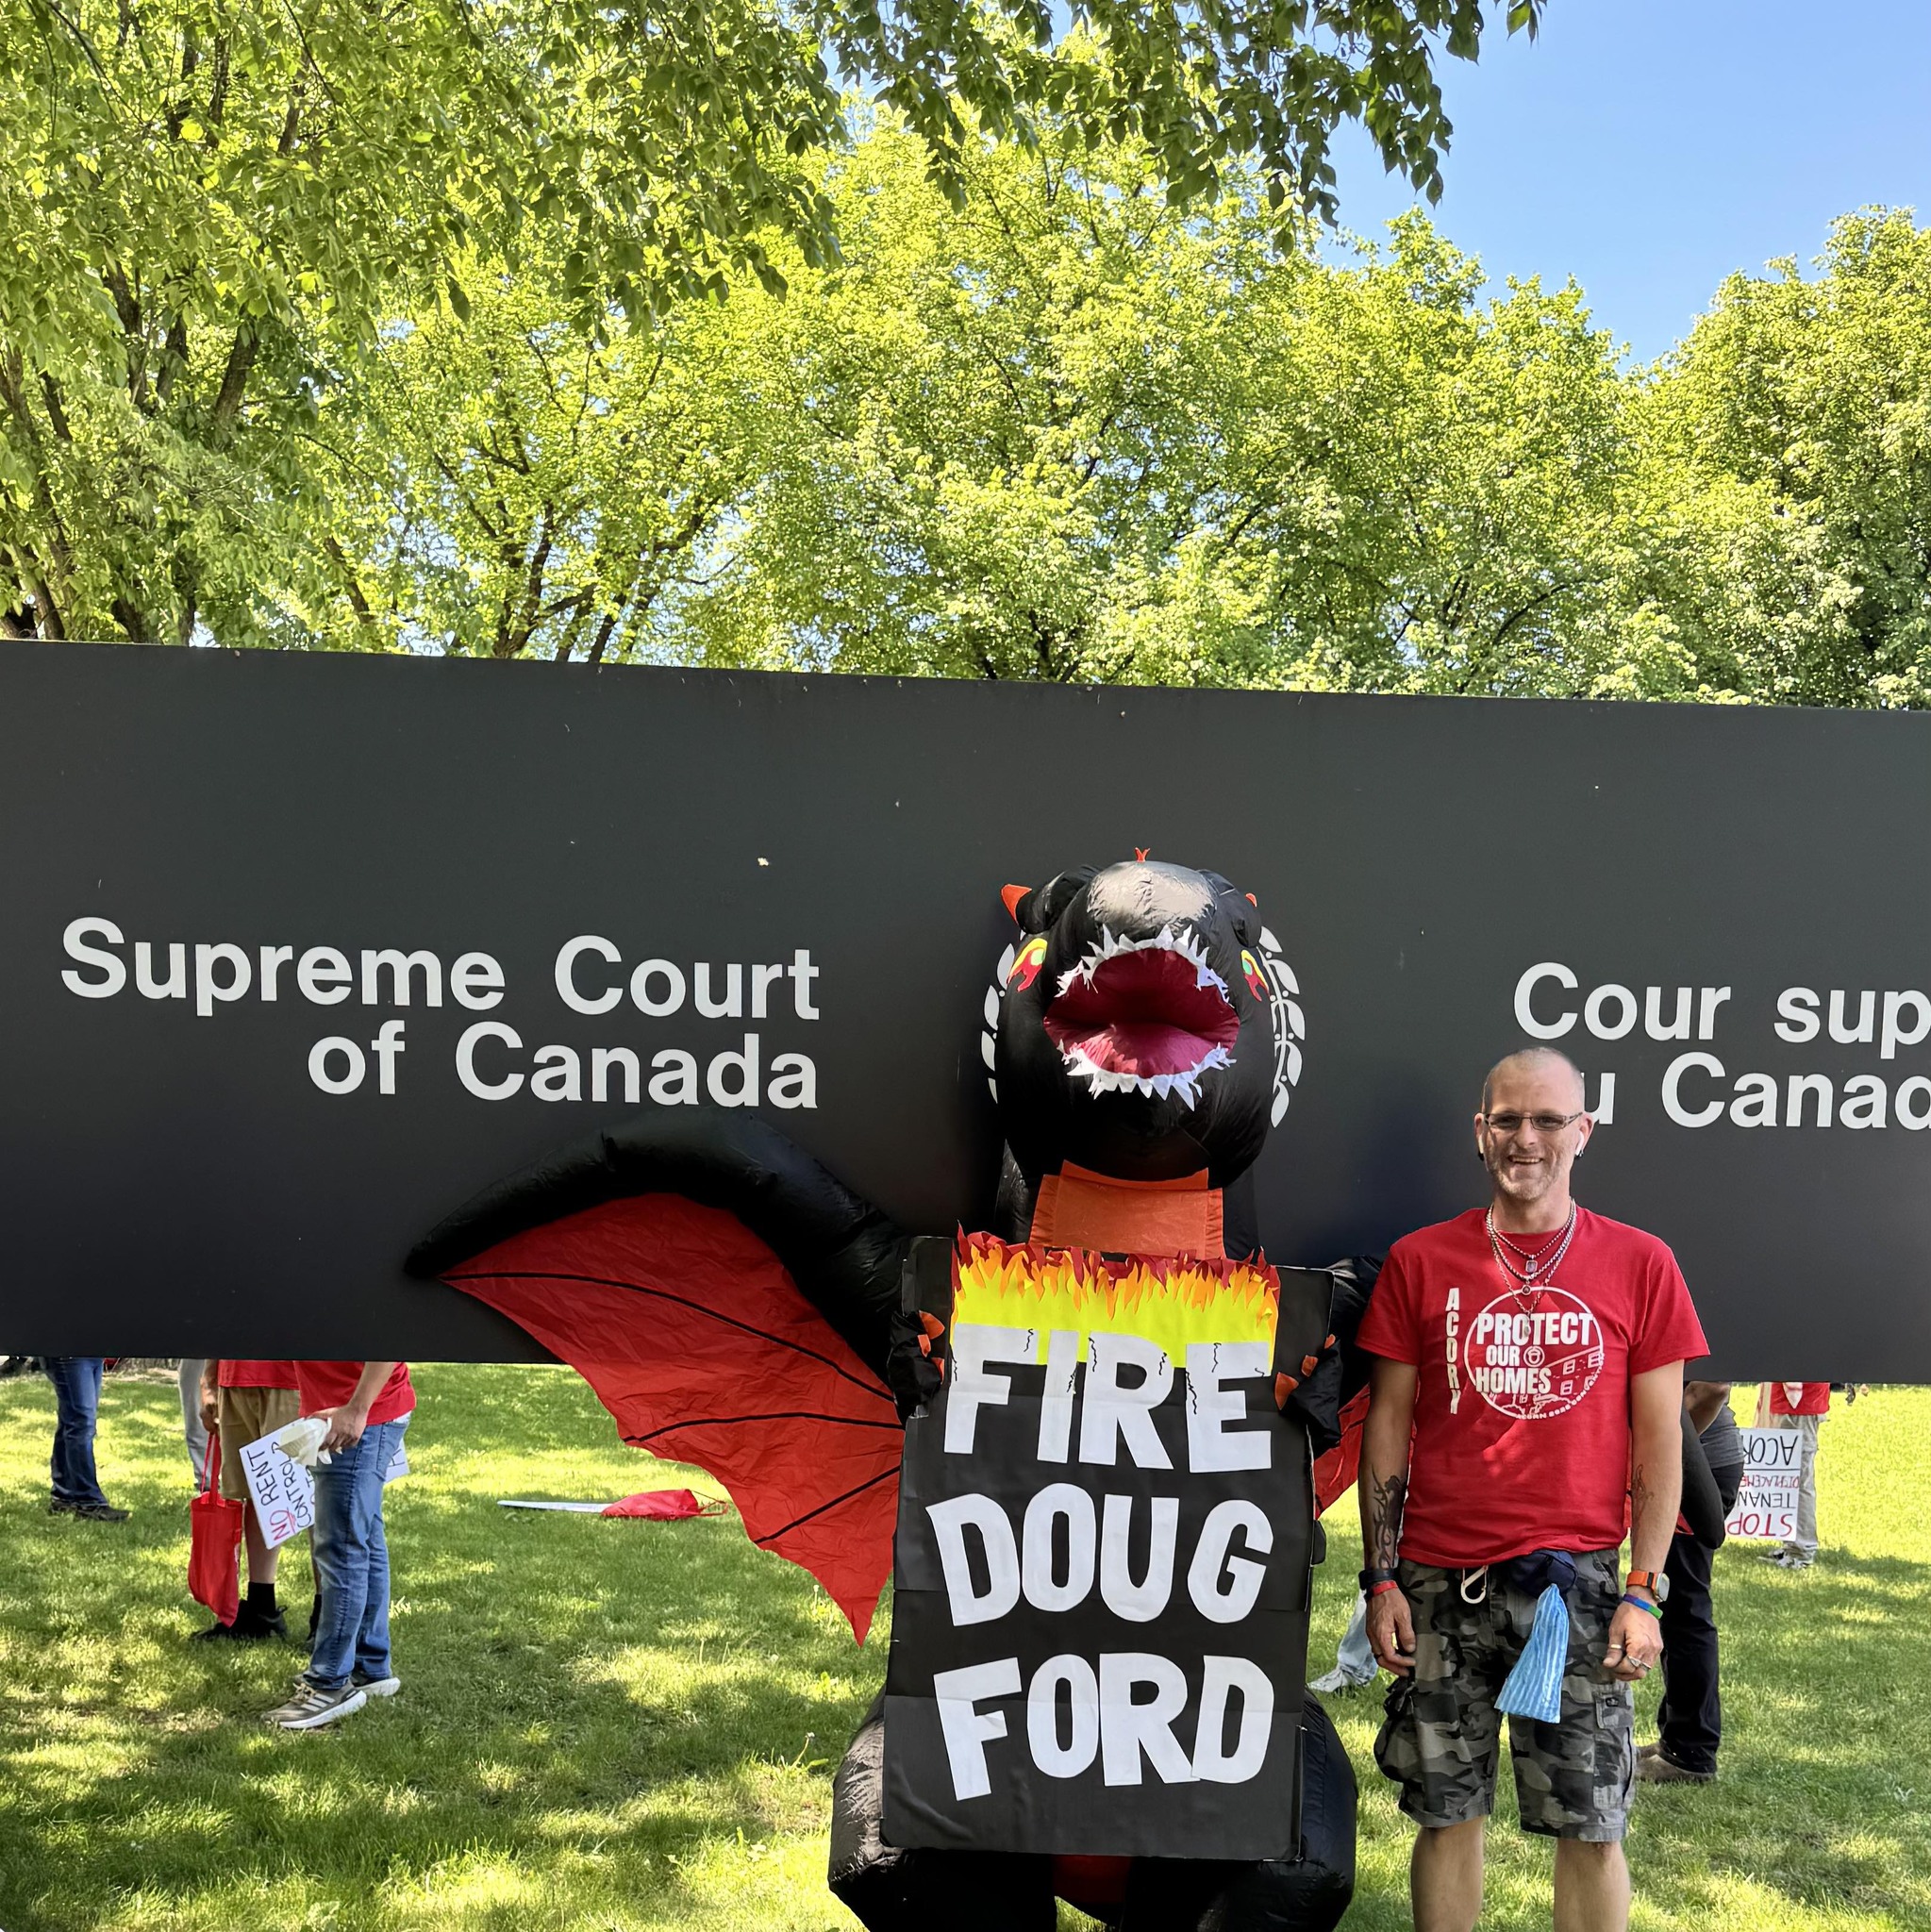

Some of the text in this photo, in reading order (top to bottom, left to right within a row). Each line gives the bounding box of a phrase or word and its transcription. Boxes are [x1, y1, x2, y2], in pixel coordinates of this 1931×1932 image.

[61, 917, 820, 1021] Supreme Court
[1513, 961, 1732, 1041] Cour
[308, 1020, 818, 1109] of Canada
[1581, 1072, 1616, 1124] u
[1475, 1311, 1594, 1346] PROTECT
[1486, 1344, 1521, 1367] OUR
[943, 1323, 1272, 1474] FIRE
[1474, 1366, 1553, 1394] HOMES
[1740, 1434, 1799, 1466] ACOR
[246, 1450, 291, 1541] NO RENT
[279, 1456, 312, 1528] CONTROL
[1726, 1512, 1794, 1538] STOP
[1737, 1491, 1797, 1509] TENAN
[925, 1482, 1273, 1626] DOUG
[933, 1652, 1275, 1802] FORD
